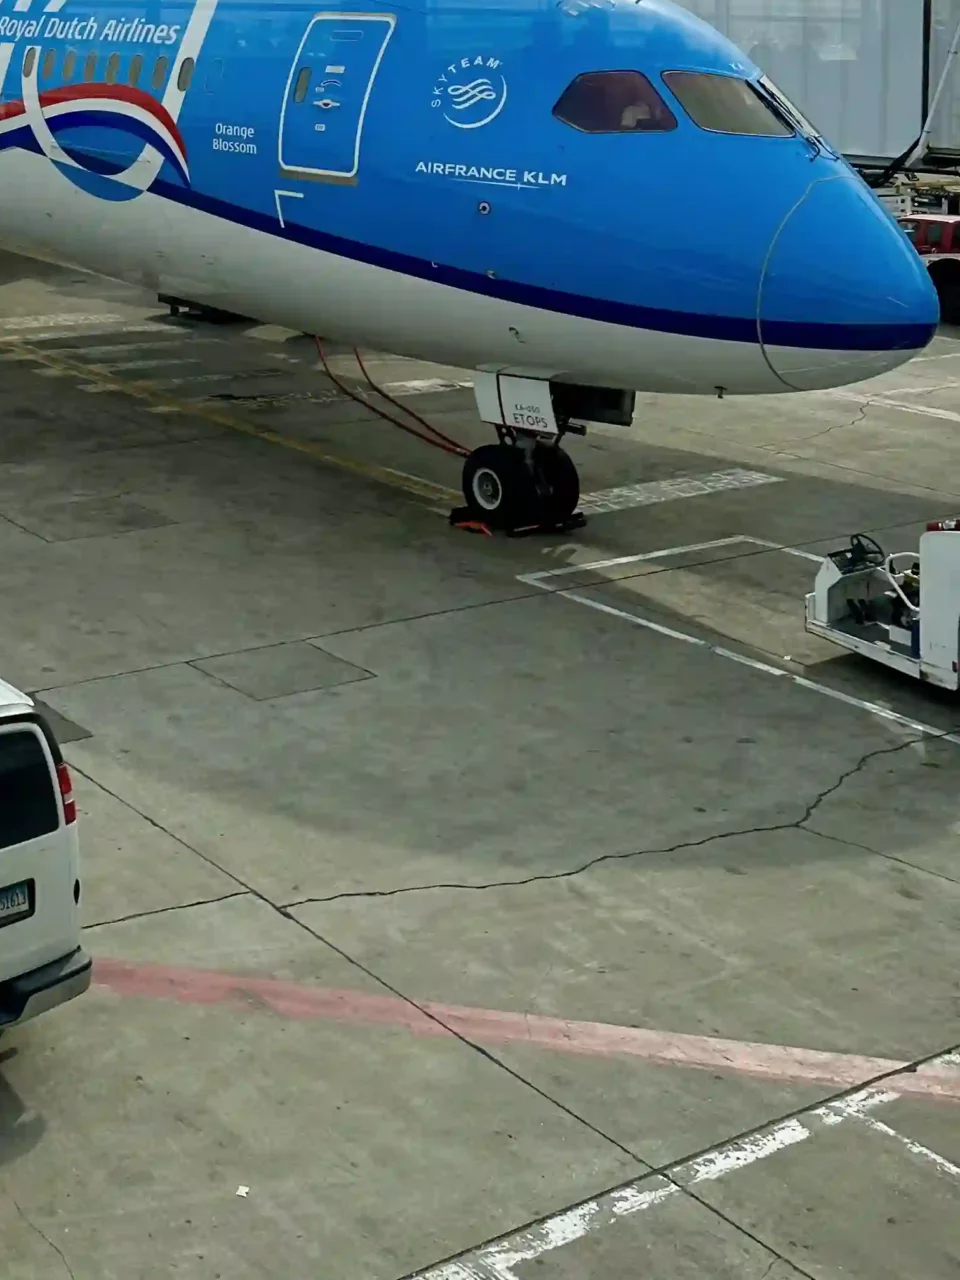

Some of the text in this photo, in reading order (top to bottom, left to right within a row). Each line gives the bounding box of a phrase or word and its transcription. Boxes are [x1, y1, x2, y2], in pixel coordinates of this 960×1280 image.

[44, 17, 98, 41] Dutch
[100, 18, 181, 45] Airlines
[431, 56, 500, 107] SKYTEAM
[215, 122, 255, 140] Orange
[212, 138, 257, 155] Blossom
[415, 161, 568, 186] AIRFRANCE KLM
[513, 412, 548, 428] ETOPS
